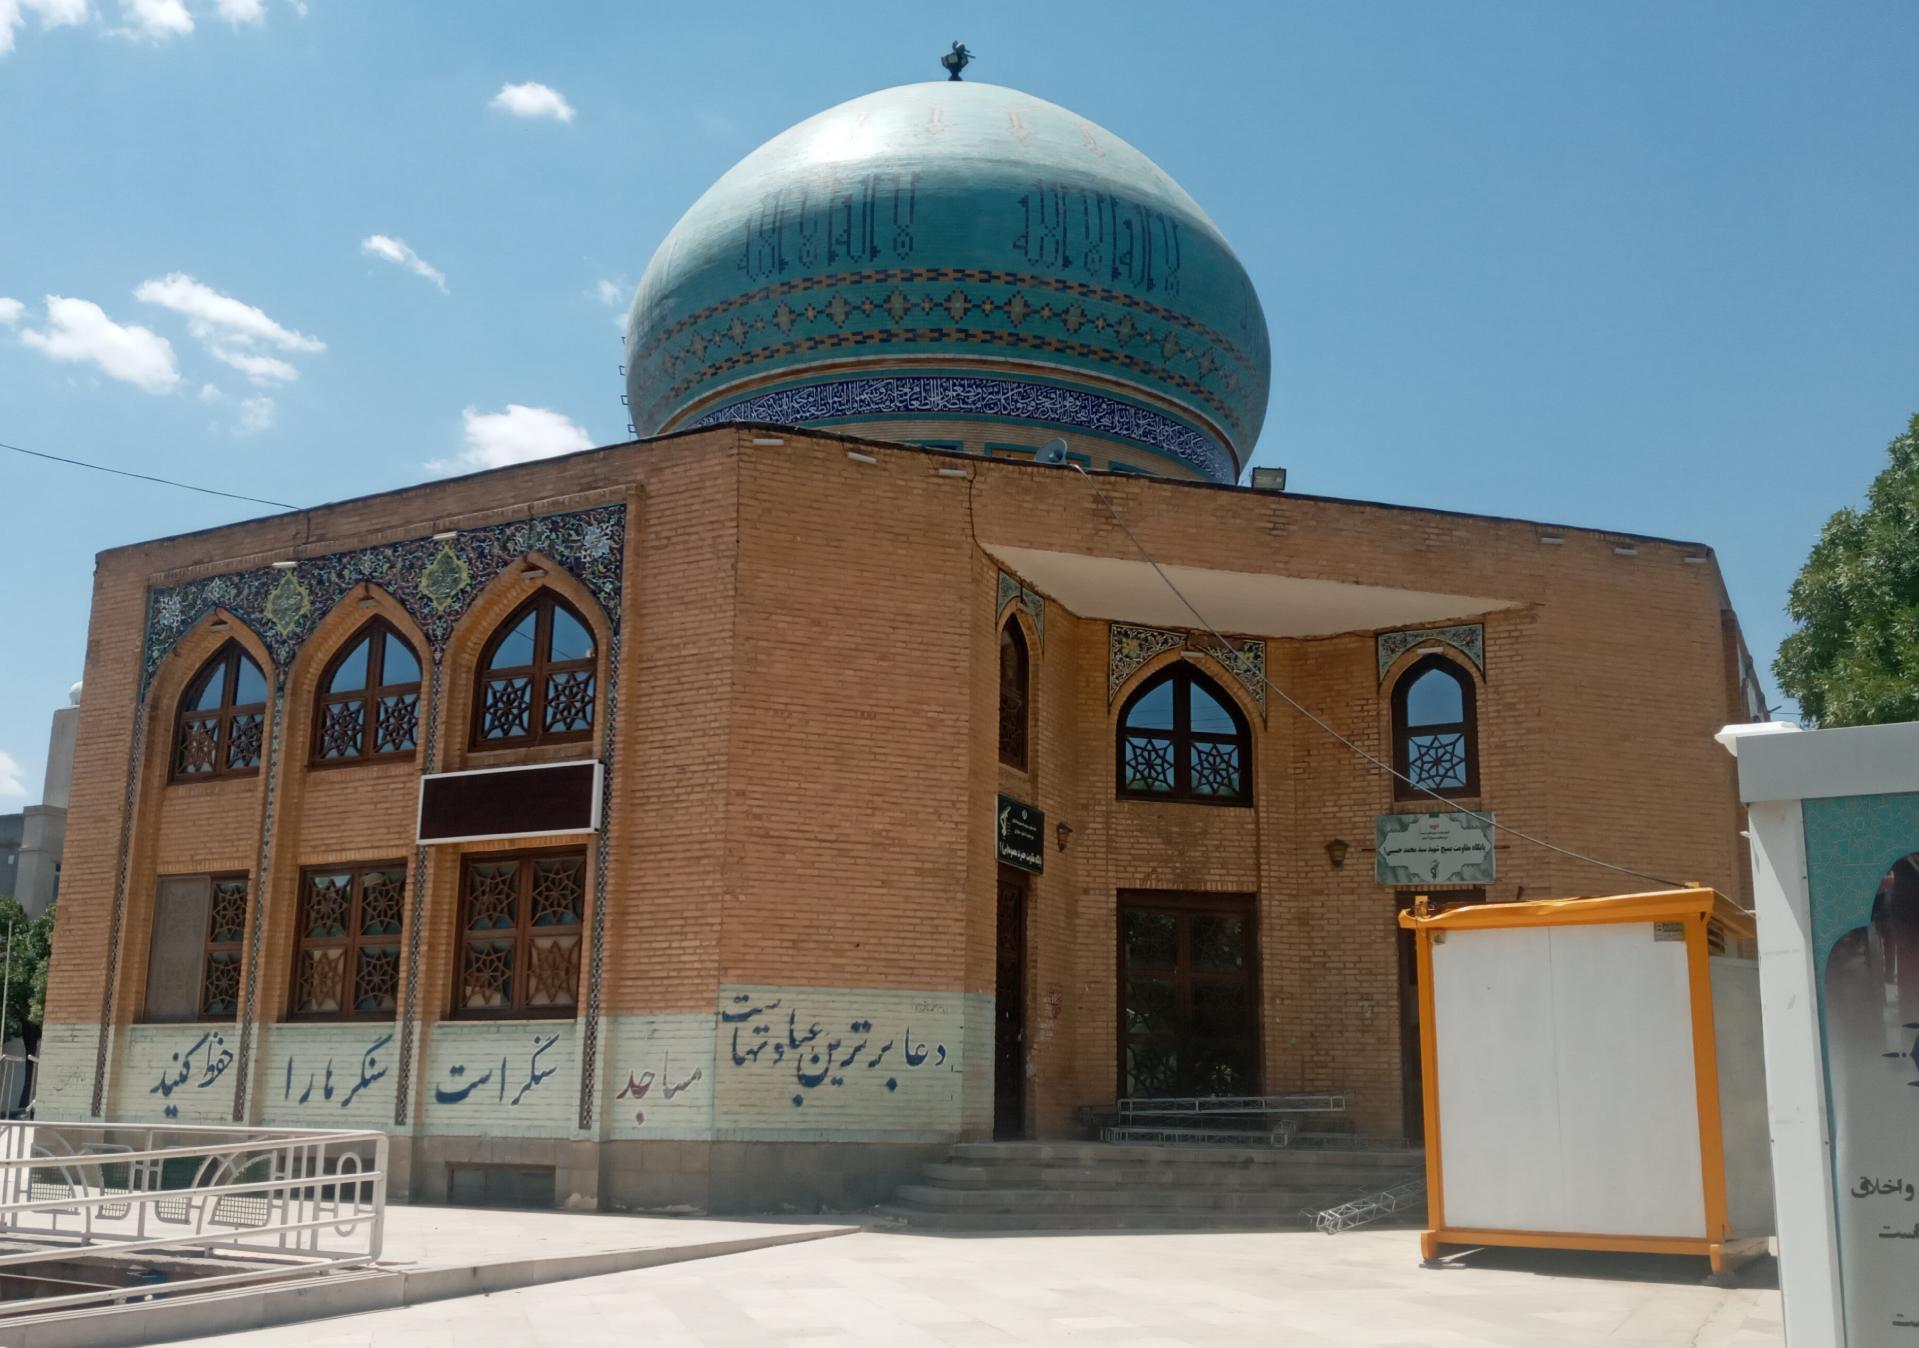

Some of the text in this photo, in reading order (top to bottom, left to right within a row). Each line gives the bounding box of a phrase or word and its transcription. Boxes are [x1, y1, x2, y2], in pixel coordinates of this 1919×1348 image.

[149, 1034, 212, 1118] کنید
[197, 1031, 235, 1089] حفظ
[510, 1034, 560, 1106] سنگر
[904, 1024, 946, 1068] دعا
[433, 1055, 507, 1105] است
[615, 1050, 703, 1127] مساجد
